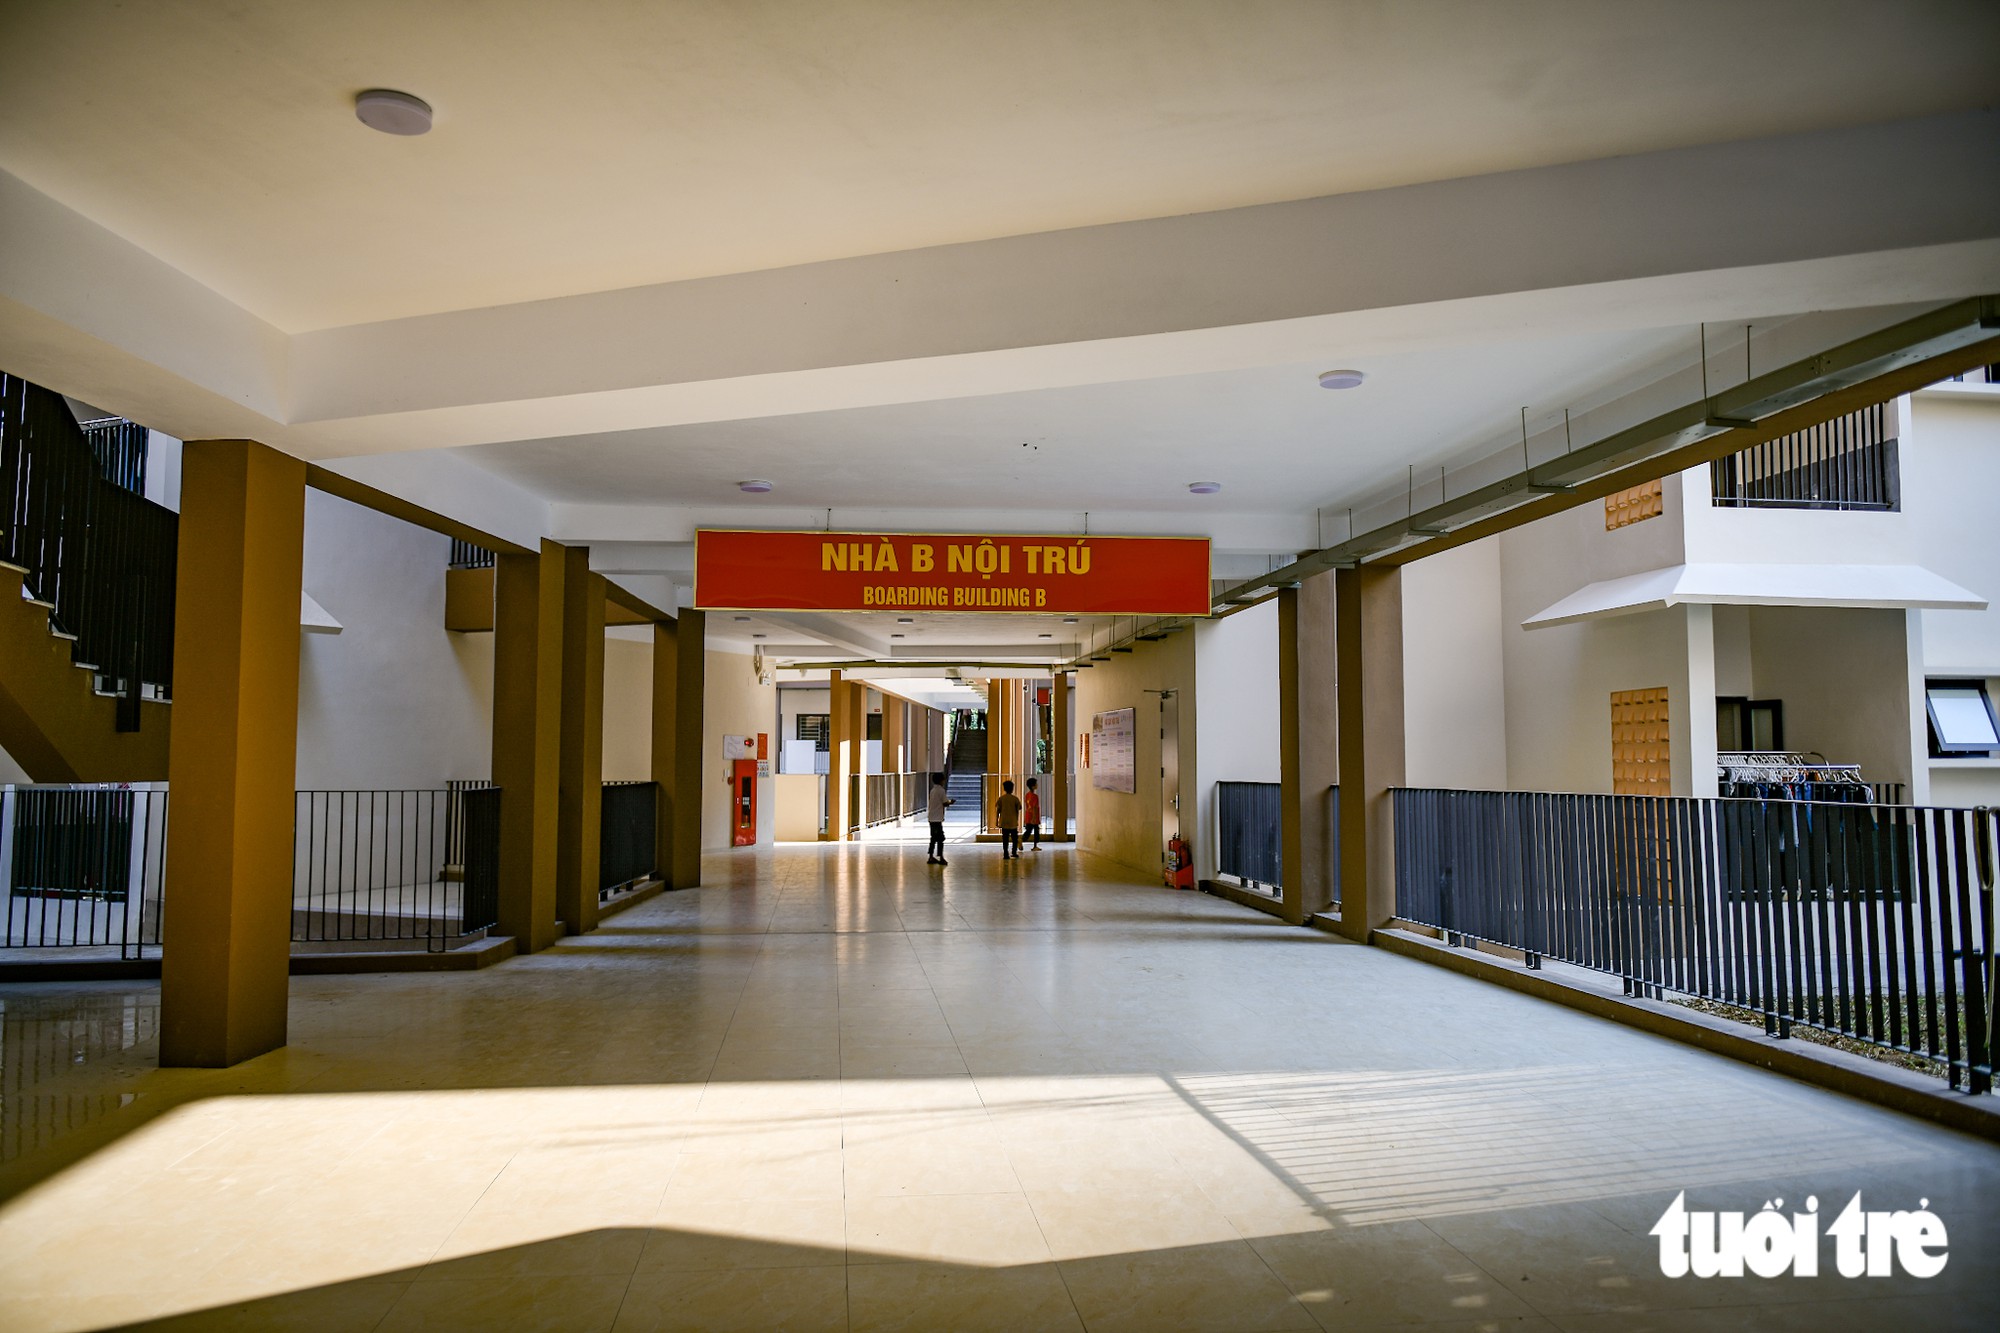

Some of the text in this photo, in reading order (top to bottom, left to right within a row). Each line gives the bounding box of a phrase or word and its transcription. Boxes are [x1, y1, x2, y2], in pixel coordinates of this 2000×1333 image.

[822, 536, 1091, 580] NHÀ B NỘI TRÚ
[863, 586, 1047, 607] BOARDING BUILDING B
